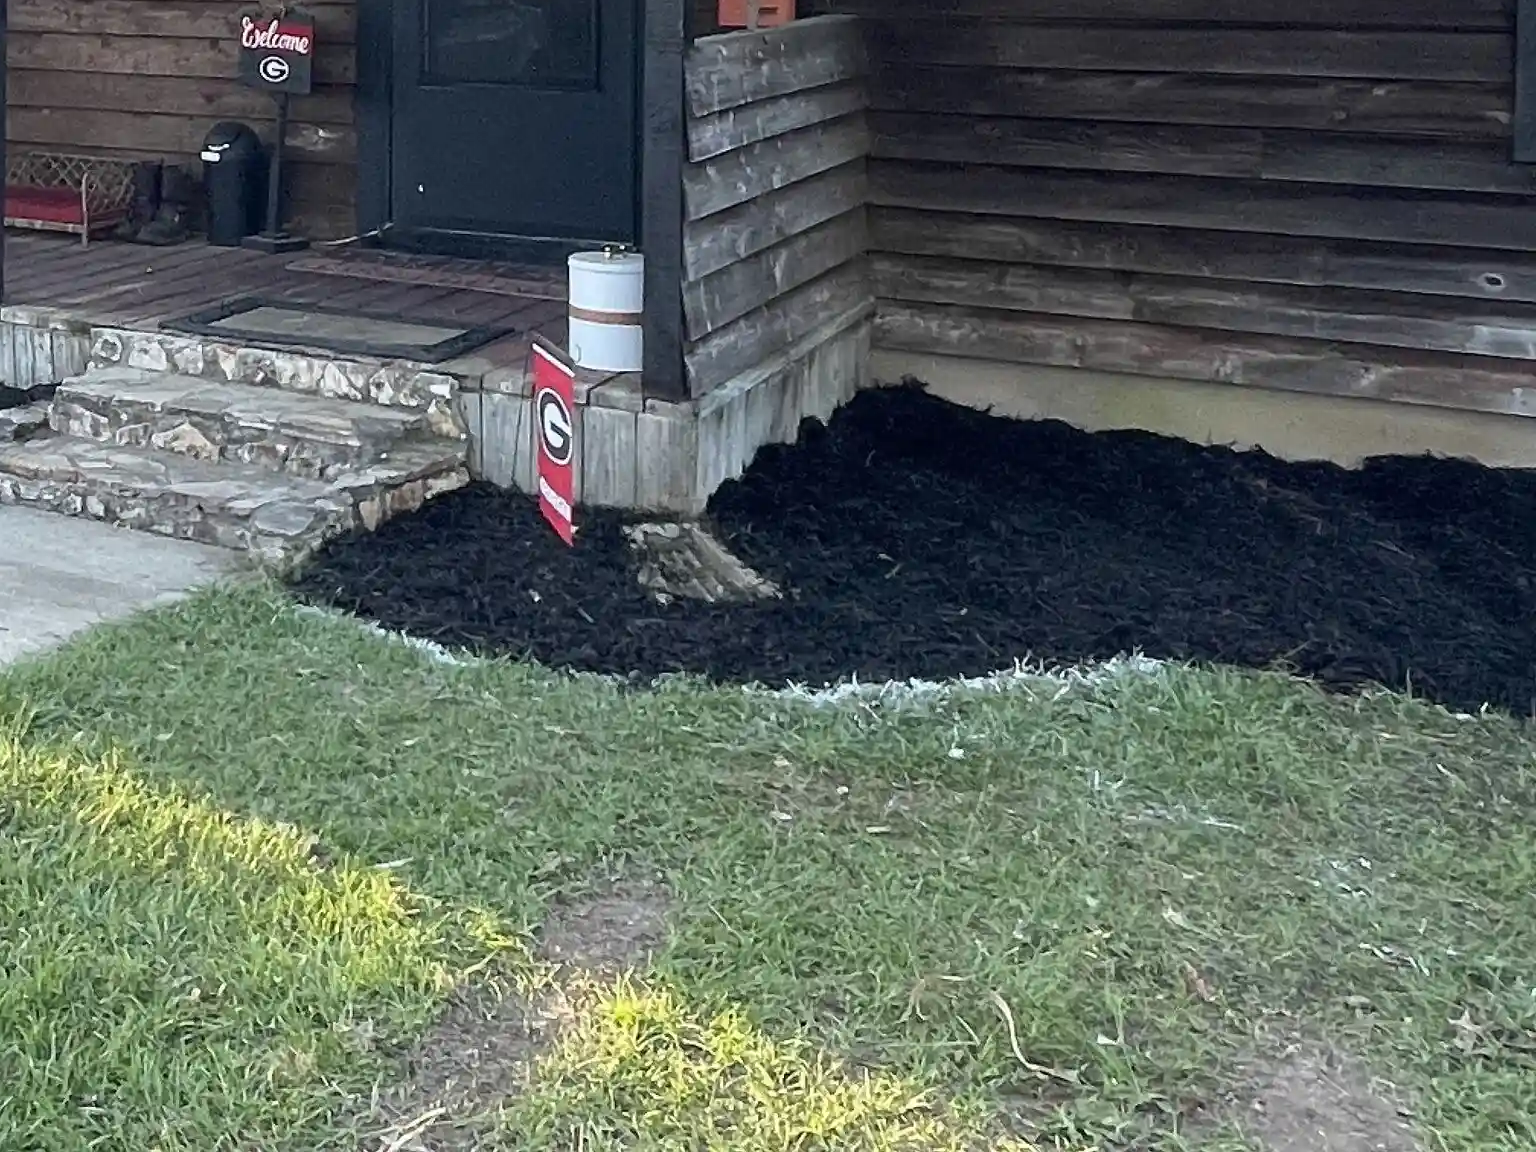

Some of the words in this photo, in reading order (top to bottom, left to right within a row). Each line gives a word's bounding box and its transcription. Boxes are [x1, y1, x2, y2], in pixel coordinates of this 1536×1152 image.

[242, 16, 309, 54] Welcome
[259, 56, 290, 83] G
[536, 387, 573, 466] G
